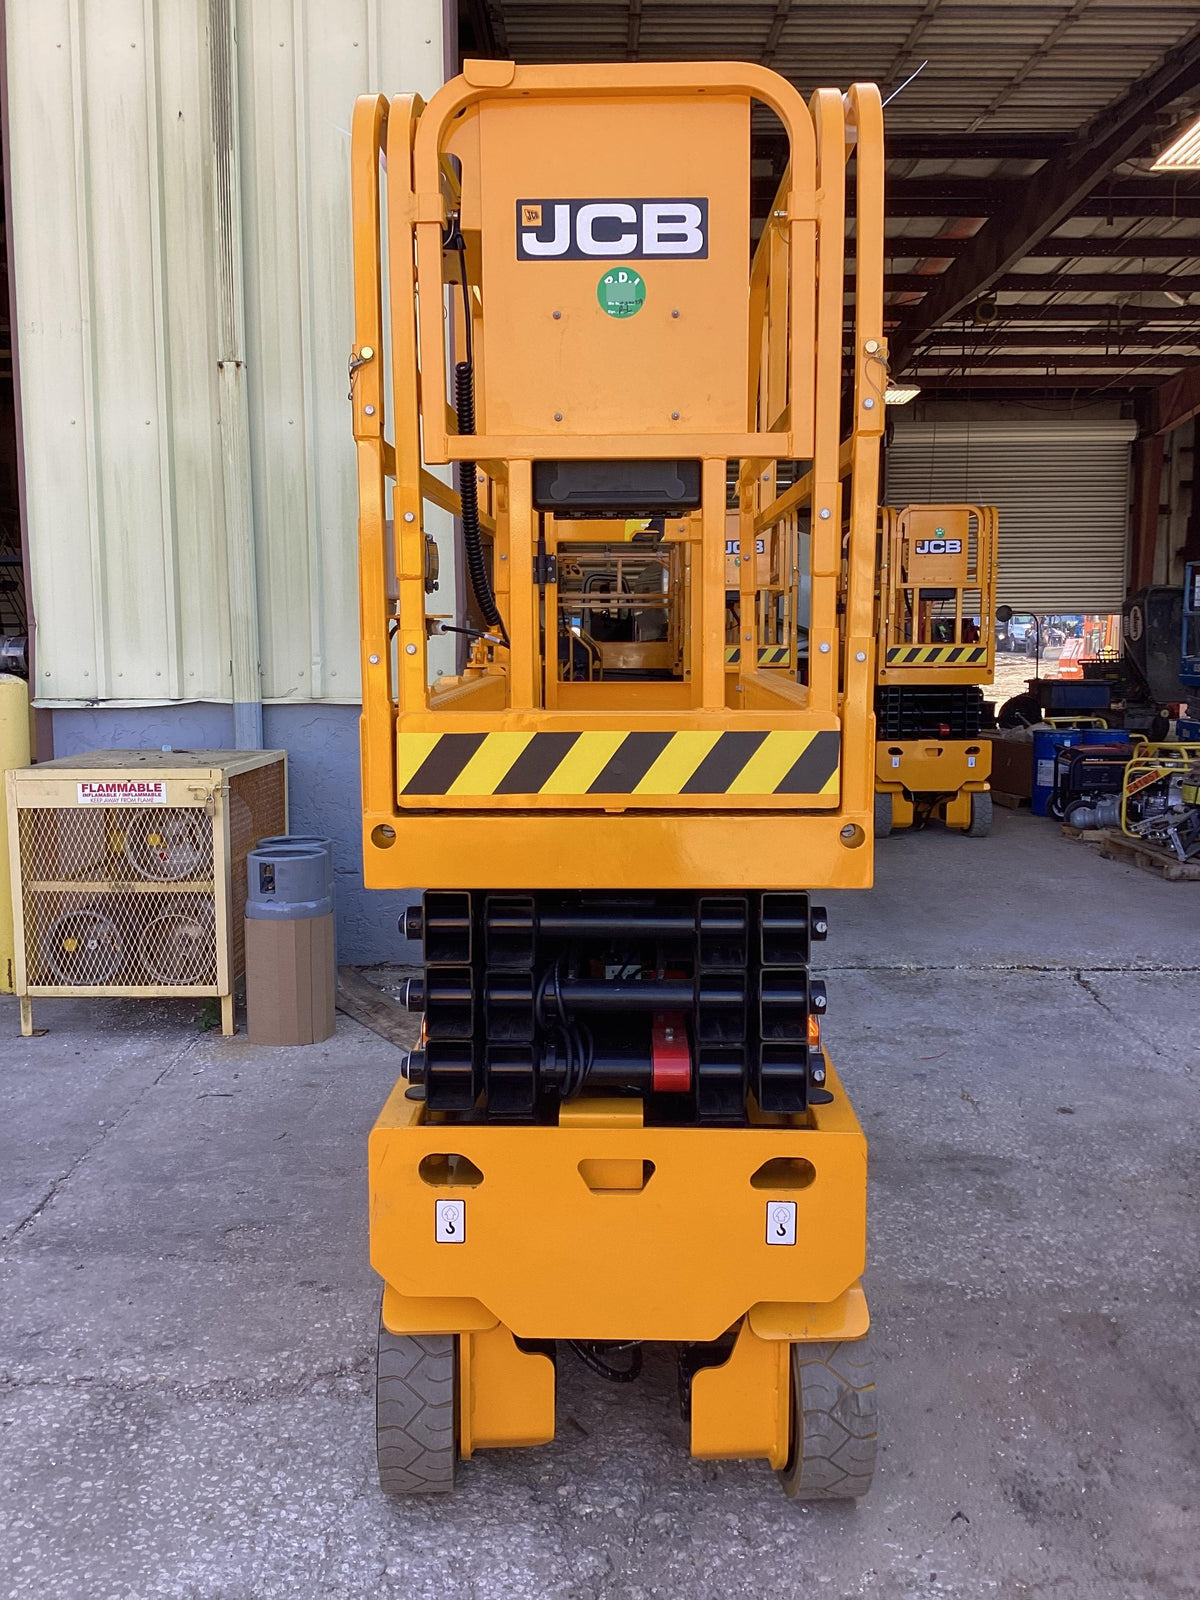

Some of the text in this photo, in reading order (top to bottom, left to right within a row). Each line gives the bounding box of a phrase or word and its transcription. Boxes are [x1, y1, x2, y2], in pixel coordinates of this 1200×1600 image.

[521, 203, 704, 256] JCB
[916, 540, 961, 554] JCB
[81, 783, 162, 793] FLAMMABLE
